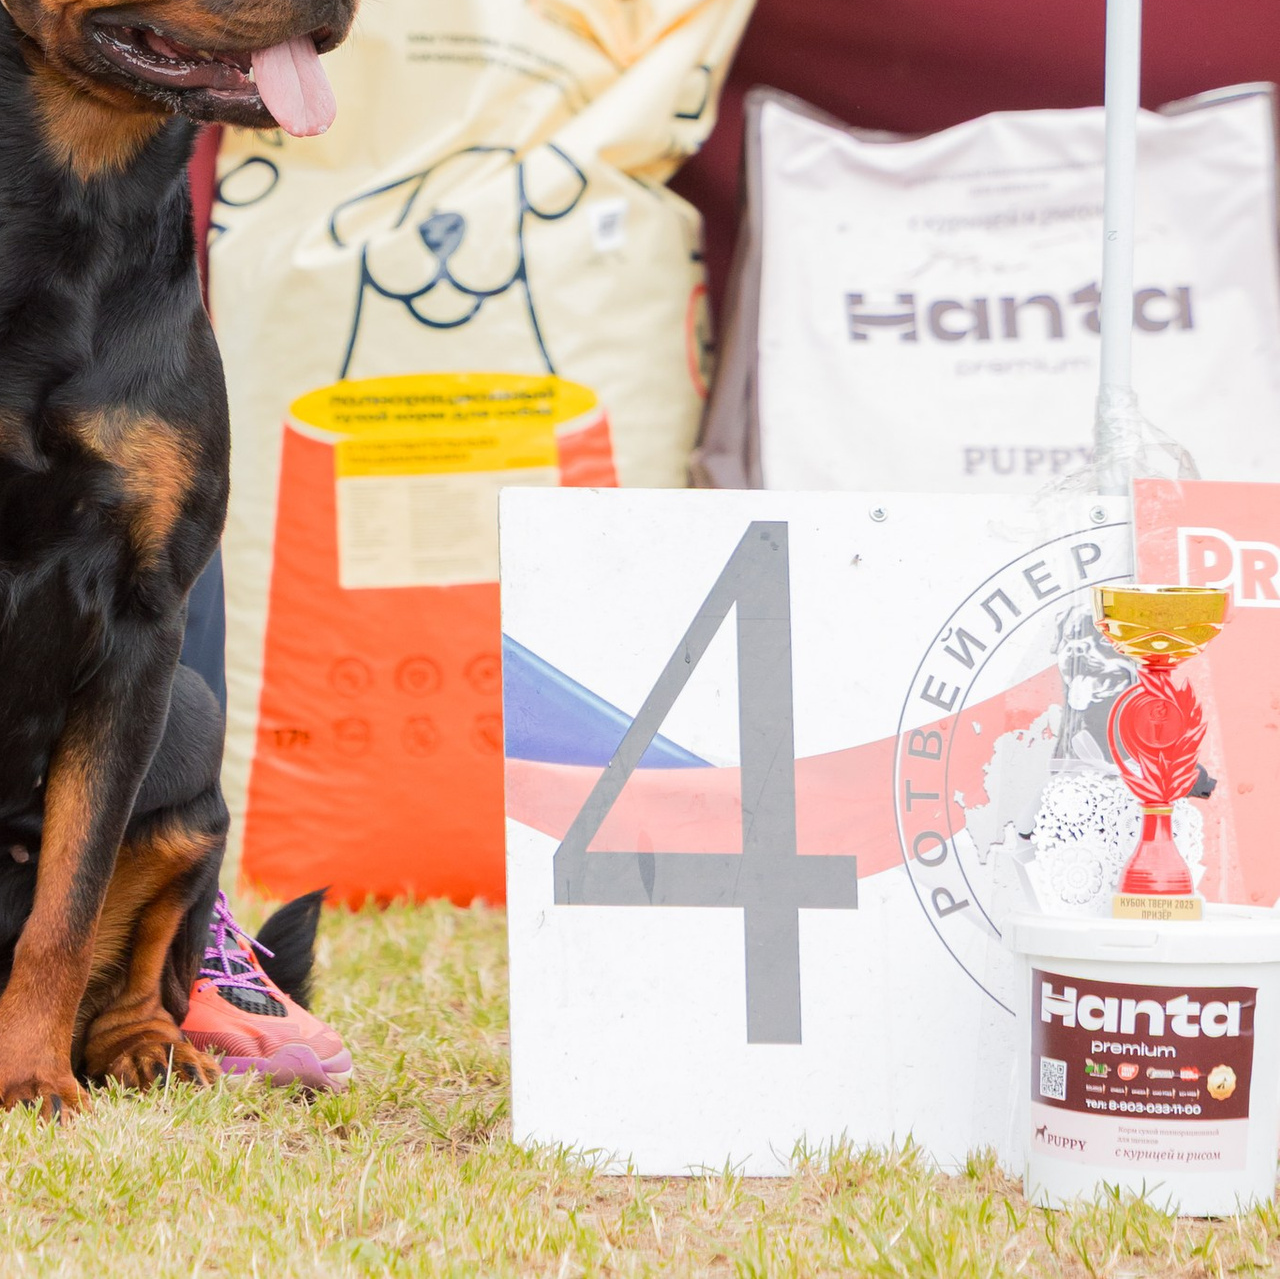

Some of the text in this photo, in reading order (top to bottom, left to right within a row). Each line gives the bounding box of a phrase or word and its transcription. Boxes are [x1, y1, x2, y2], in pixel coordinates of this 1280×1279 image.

[846, 282, 1194, 343] Hanta
[905, 542, 1102, 918] РОТВЕЙЛЕР
[553, 520, 858, 1045] 4
[1120, 898, 1194, 909] КУБОК ТВЕРИ 2025
[1041, 982, 1240, 1037] Hanta
[1091, 1040, 1177, 1058] premium
[1047, 1134, 1087, 1152] PUPPY
[1123, 1148, 1175, 1162] курицей
[1177, 1152, 1184, 1160] и
[1186, 1152, 1221, 1163] рисом
